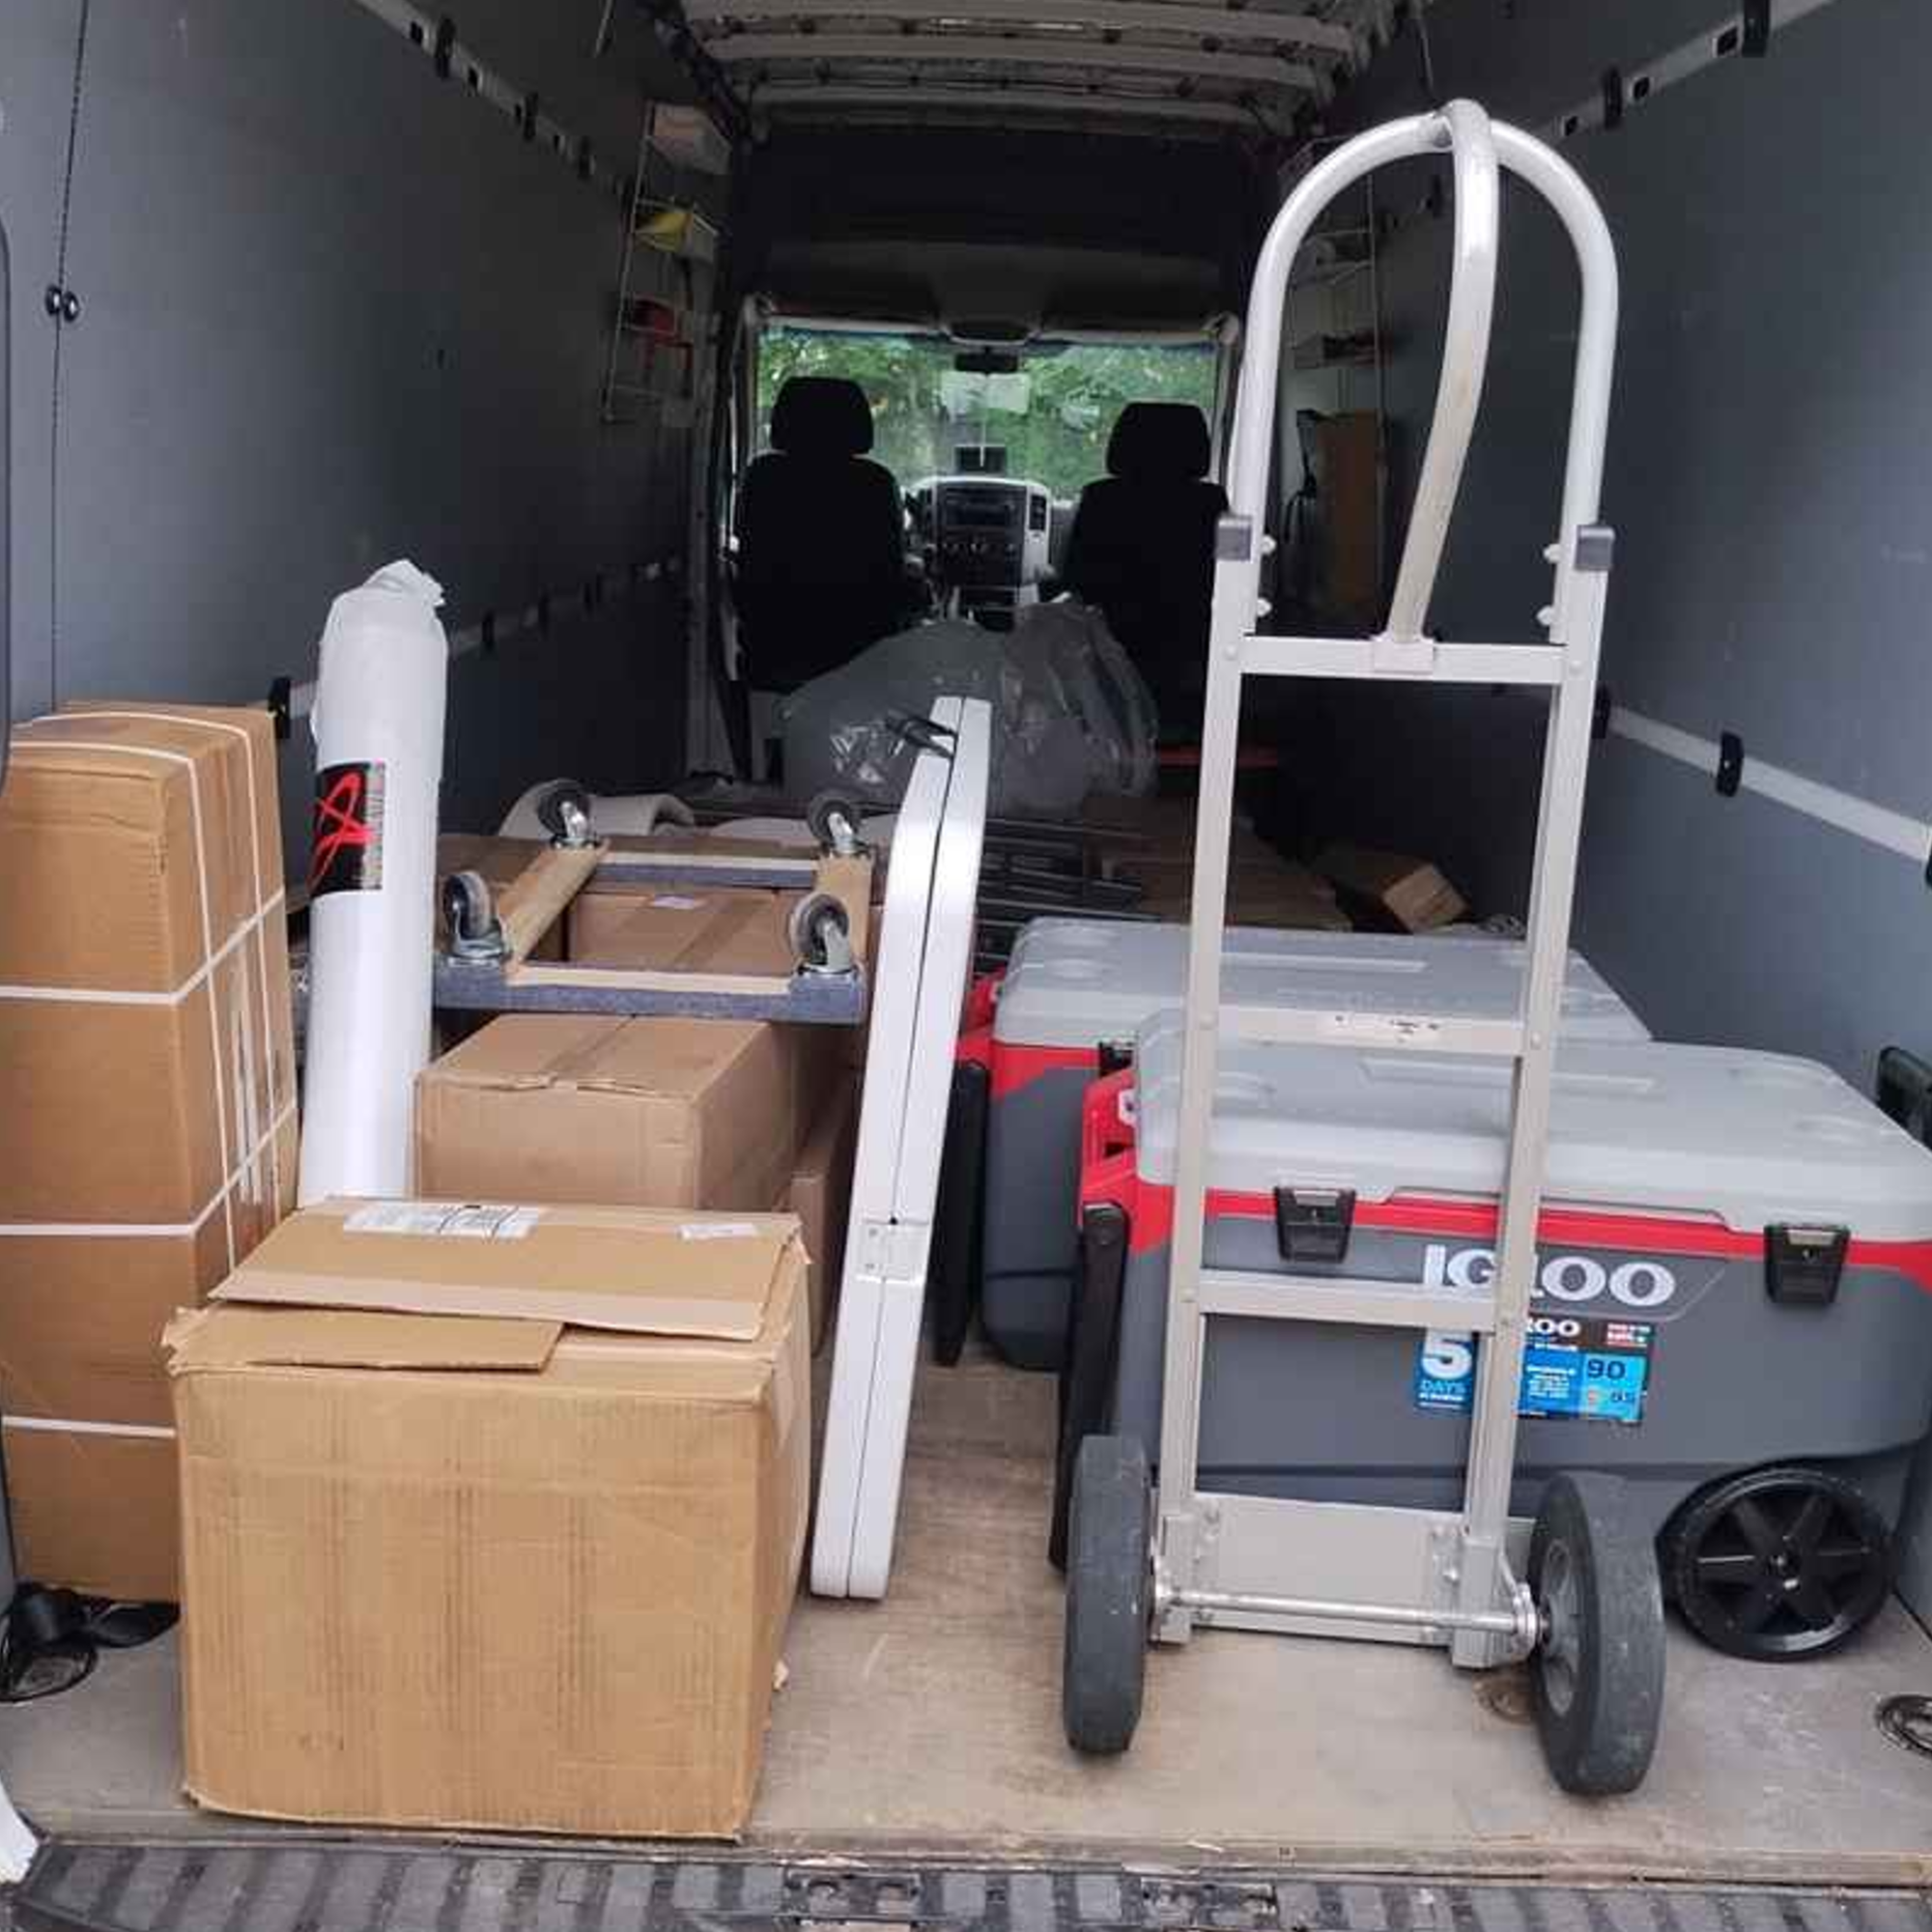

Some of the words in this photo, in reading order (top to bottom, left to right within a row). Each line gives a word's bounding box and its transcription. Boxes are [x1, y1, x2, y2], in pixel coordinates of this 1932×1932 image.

[1423, 1244, 1676, 1306] IGOO
[1422, 1330, 1472, 1379] 5
[1587, 1358, 1626, 1380] 90
